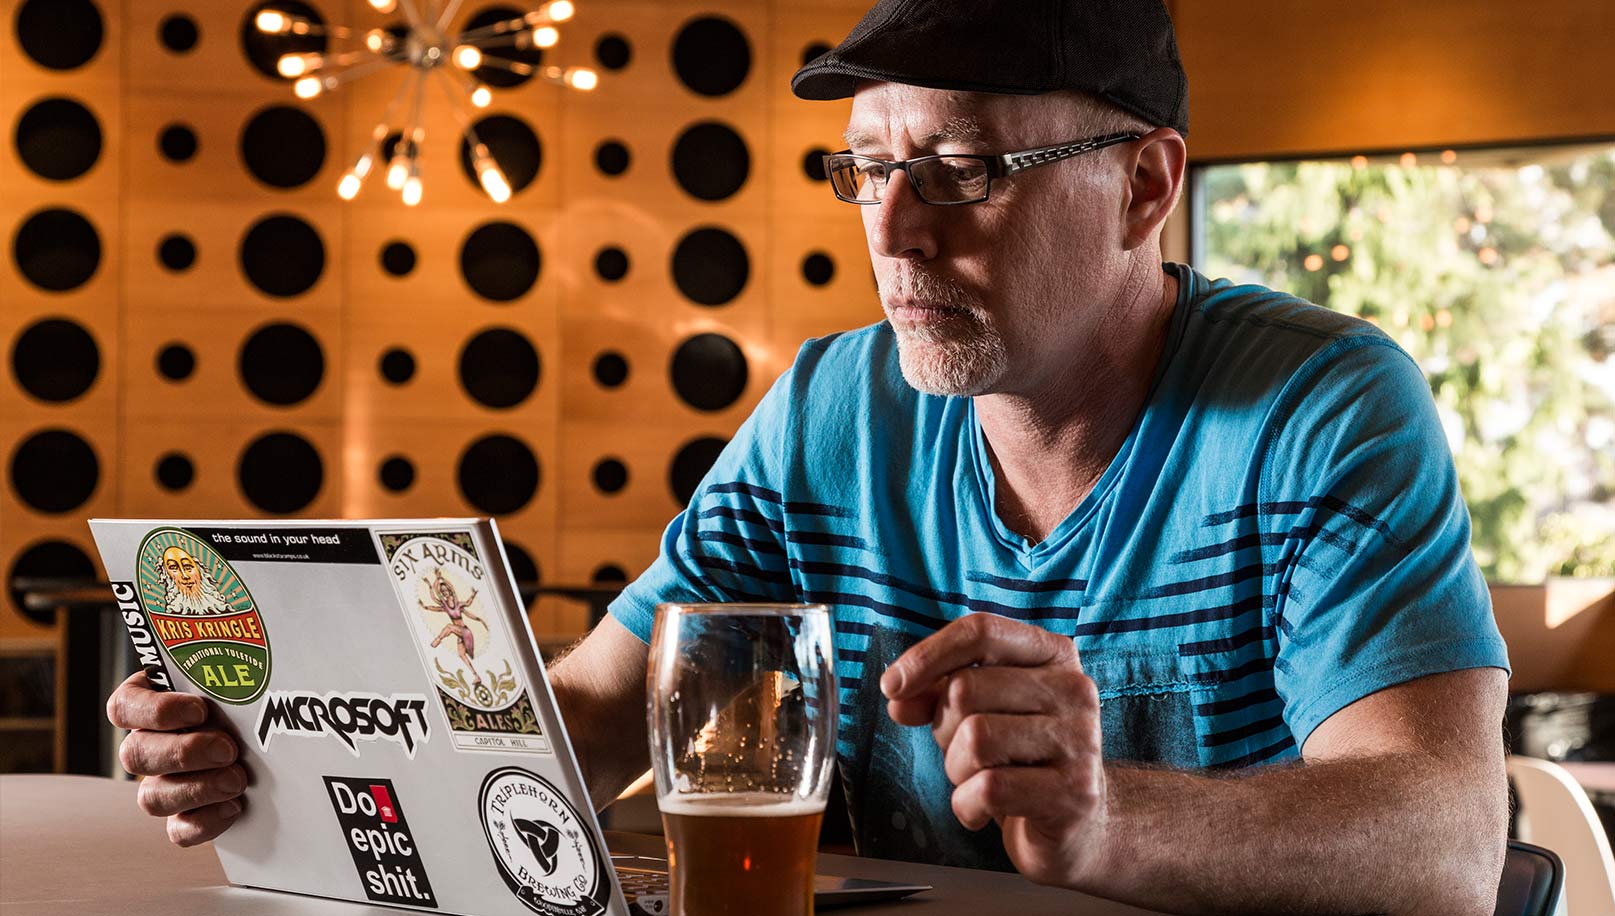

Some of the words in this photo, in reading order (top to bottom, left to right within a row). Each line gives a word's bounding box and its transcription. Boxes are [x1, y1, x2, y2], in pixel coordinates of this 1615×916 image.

[212, 533, 232, 544] the
[234, 533, 268, 545] sound
[271, 534, 281, 545] in
[283, 535, 310, 547] your
[311, 534, 341, 545] head
[393, 547, 419, 581] SIX
[111, 583, 162, 667] MUSIC
[156, 618, 194, 641] KRIS
[195, 617, 262, 640] KRINGLE
[183, 647, 224, 671] TRADITIONAL
[225, 648, 263, 671] YULETIDE
[202, 664, 256, 687] ALE
[258, 696, 428, 754] MICROSOFT
[476, 713, 513, 731] ALES
[474, 737, 506, 747] CAPITOL
[510, 738, 528, 748] HILL
[331, 781, 377, 816] Do
[350, 823, 412, 861] epic
[366, 864, 431, 900] shit.
